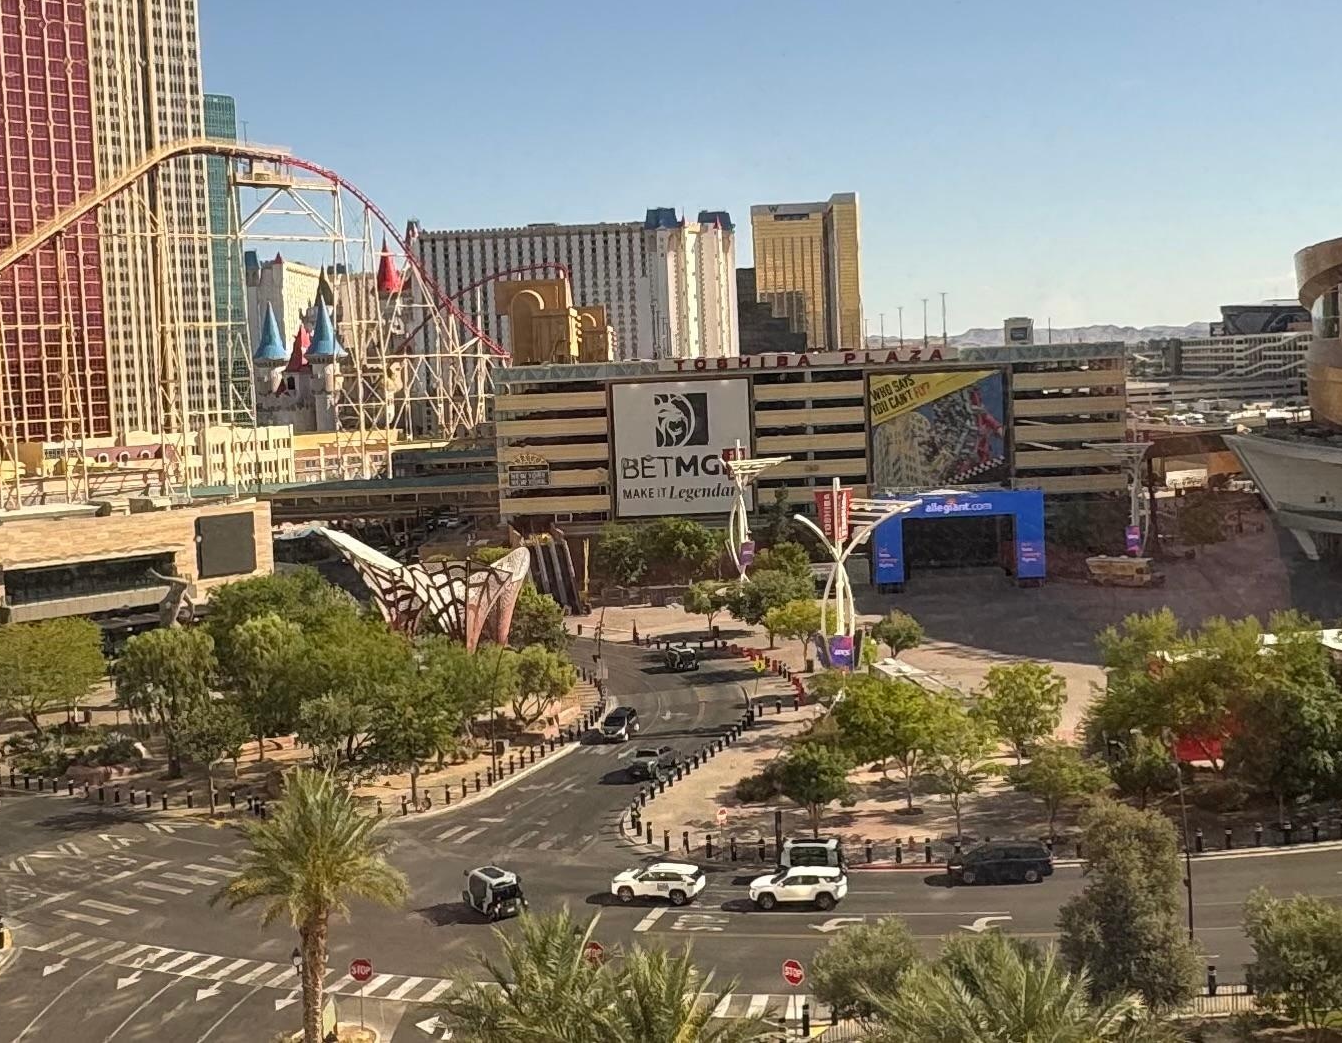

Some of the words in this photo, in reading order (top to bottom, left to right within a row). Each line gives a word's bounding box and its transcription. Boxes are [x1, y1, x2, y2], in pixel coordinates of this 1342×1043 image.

[674, 353, 811, 373] TOSHIBA
[844, 348, 944, 366] PLAZA
[871, 384, 893, 401] WHO
[892, 375, 915, 392] SAYS
[872, 400, 889, 416] YOU
[622, 455, 727, 479] BETMG
[623, 488, 654, 499] MAKE
[657, 487, 667, 498] IT
[669, 482, 735, 503] Legendar
[925, 502, 992, 514] allegiant.com
[351, 965, 371, 975] STOP
[784, 966, 802, 978] STOP
